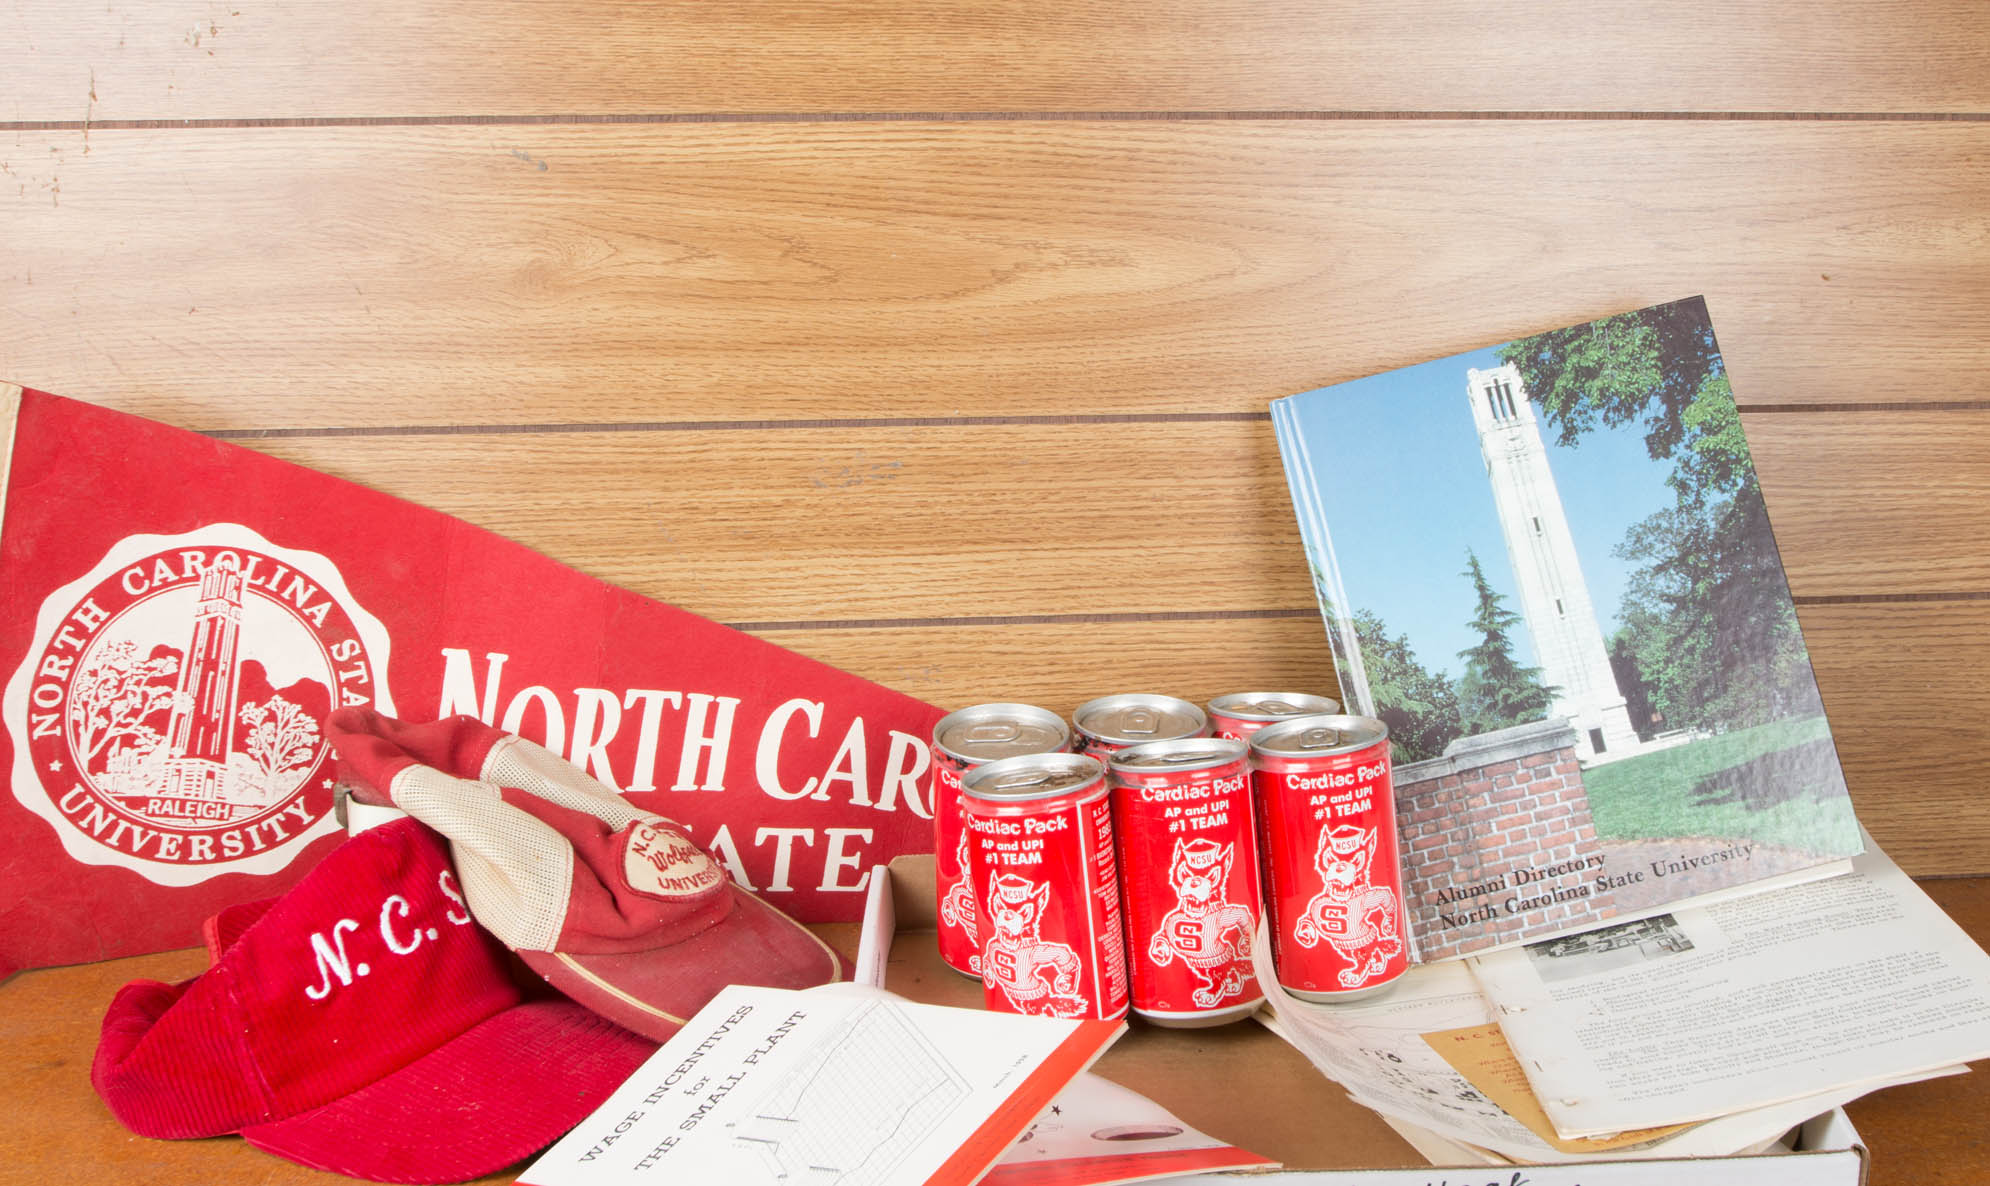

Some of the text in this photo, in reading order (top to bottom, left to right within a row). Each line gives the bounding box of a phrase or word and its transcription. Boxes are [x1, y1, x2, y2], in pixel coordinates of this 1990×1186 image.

[33, 550, 370, 740] NORTH CAROLINA STA
[438, 648, 935, 820] NORTH CAR
[1286, 760, 1386, 790] Cardiac Pack
[1141, 774, 1244, 802] Cardiac Pack
[1310, 785, 1373, 806] AP and UPI
[147, 798, 230, 820] RALEIGH
[1165, 799, 1229, 818] AP and UPI
[1314, 798, 1372, 820] #1 TEAM
[59, 784, 315, 861] UNIVERSITY
[967, 813, 1068, 835] Cardiac Pack
[1168, 812, 1228, 833] #1 TEAM
[982, 839, 1044, 851] AP and UPI
[1336, 839, 1357, 851] NCSU
[683, 823, 873, 893] ATE
[985, 852, 1043, 865] #1 TEAM
[1190, 854, 1212, 865] NCSU
[1436, 855, 1606, 906] Alumni Directory
[1440, 843, 1754, 930] North Carolina State University
[1002, 887, 1024, 900] NCSU
[578, 1005, 754, 1163] WAGE INCENTIVES
[633, 1010, 807, 1171] THE SMALL PLANT
[684, 1075, 711, 1096] for
